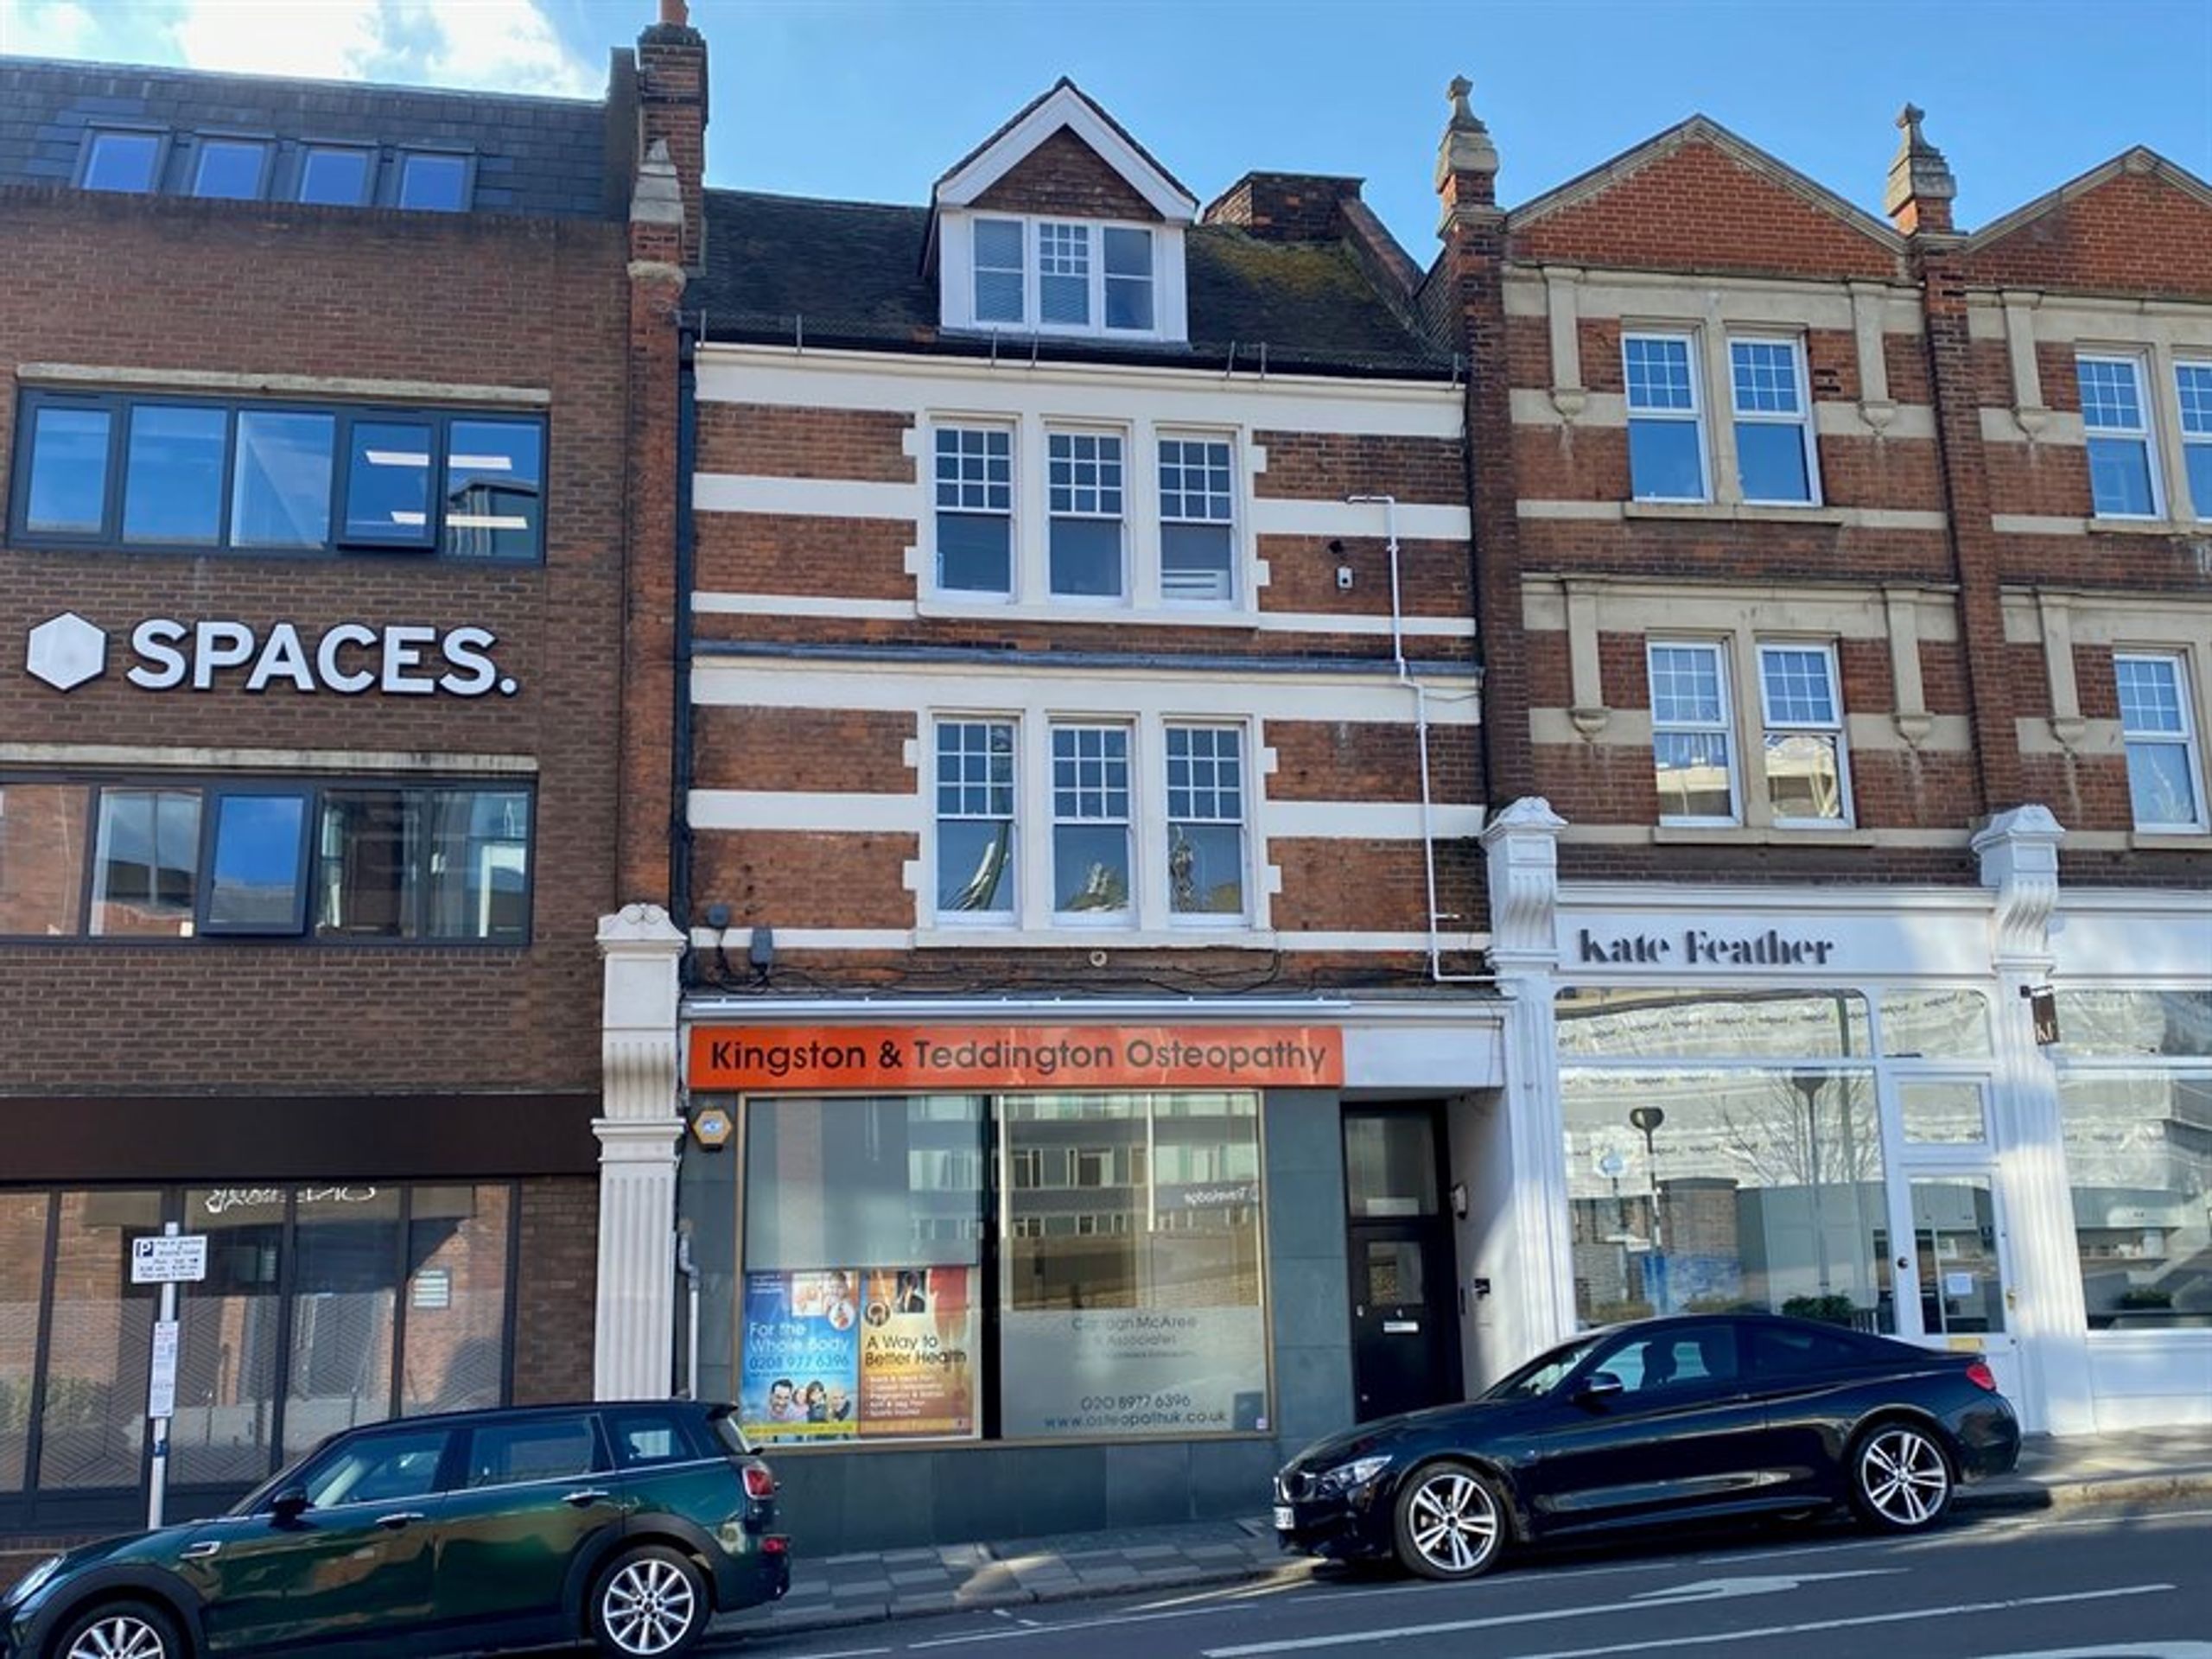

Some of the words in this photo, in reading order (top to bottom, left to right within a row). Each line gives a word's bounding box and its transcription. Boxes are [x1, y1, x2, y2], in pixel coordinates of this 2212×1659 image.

[126, 618, 518, 696] SPACES.
[1686, 929, 1834, 964] Feather
[711, 1040, 867, 1077] Kingston
[879, 1040, 903, 1069] &
[913, 1039, 1115, 1075] Teddington
[1126, 1039, 1326, 1075] Osteopathy
[749, 1322, 774, 1338] For
[779, 1322, 807, 1336] the
[749, 1339, 803, 1355] Whole
[808, 1338, 849, 1353] Body
[867, 1335, 878, 1349] A
[882, 1334, 918, 1349] Way
[923, 1334, 938, 1348] to
[786, 1355, 812, 1368] 977
[865, 1351, 911, 1366] Better
[914, 1348, 967, 1365] Health
[1081, 1396, 1115, 1411] 020
[1118, 1395, 1151, 1409] 8977
[1154, 1393, 1191, 1408] 6396
